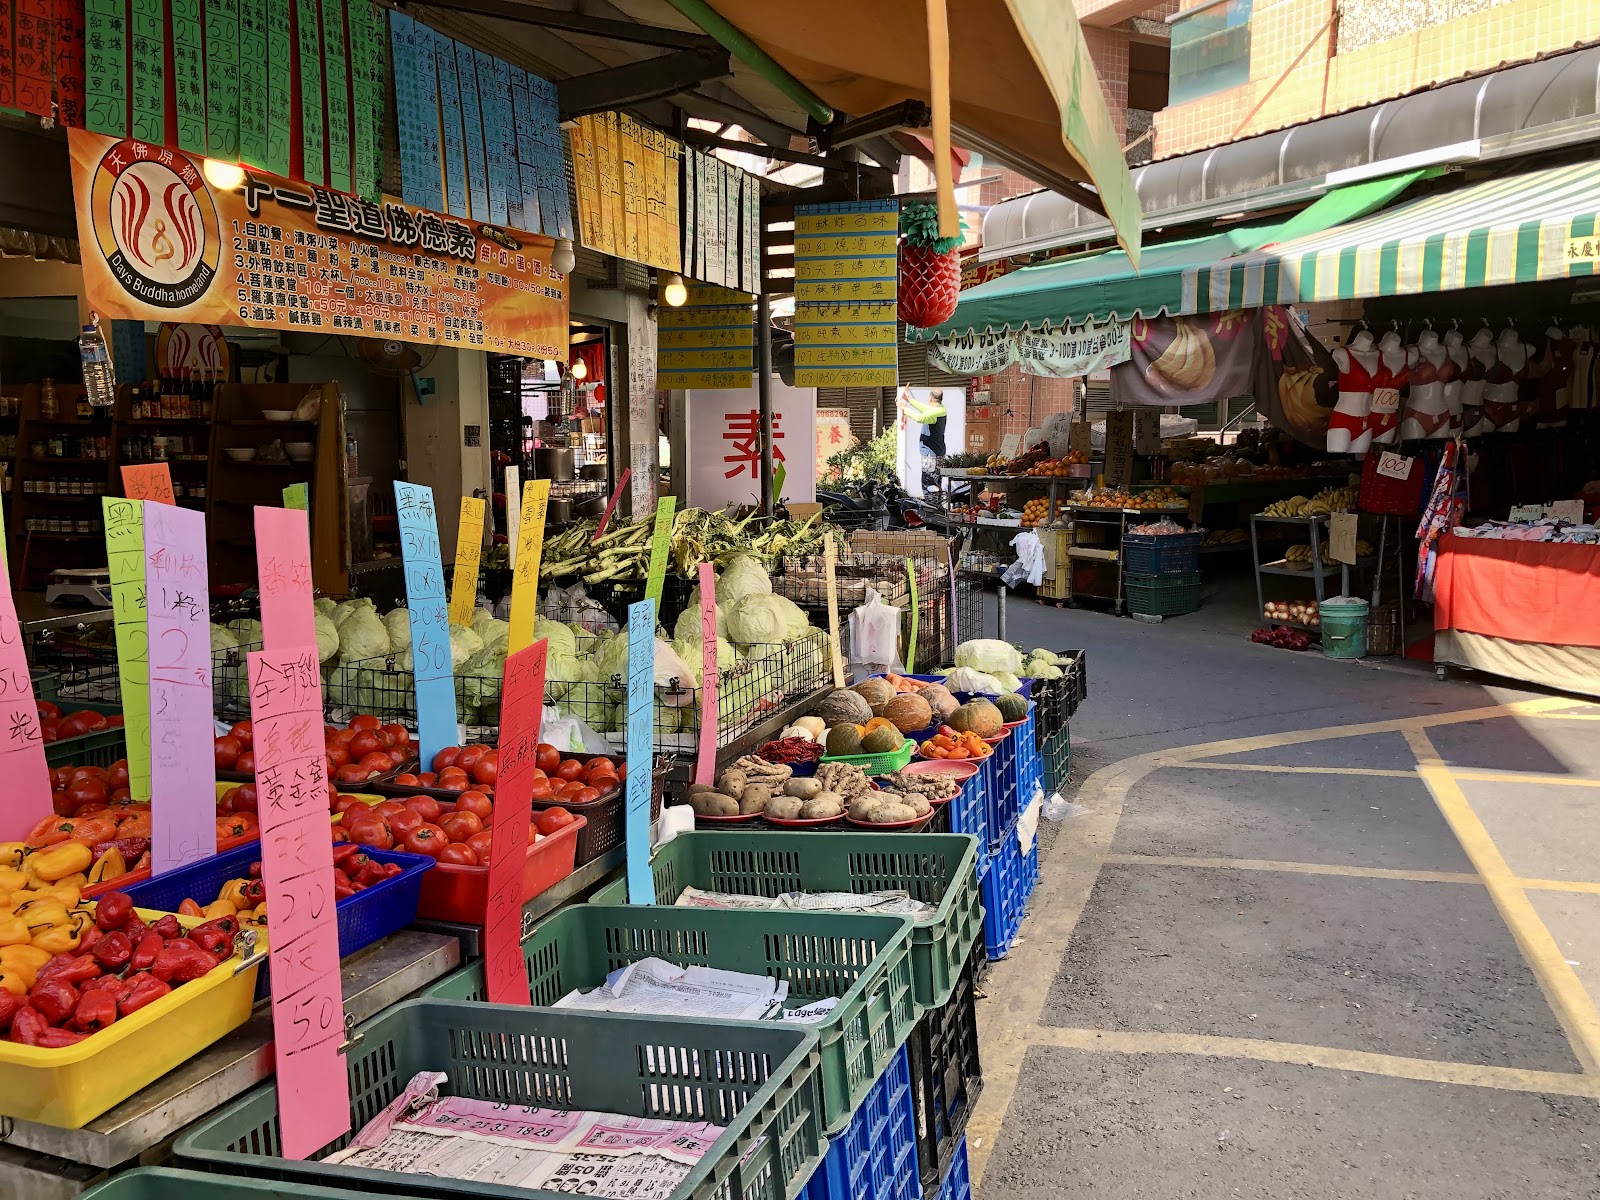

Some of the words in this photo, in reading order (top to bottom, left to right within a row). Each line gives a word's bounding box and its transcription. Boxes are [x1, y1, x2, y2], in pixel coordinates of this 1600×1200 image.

[209, 123, 236, 155] 50
[110, 253, 133, 285] Days
[132, 279, 176, 303] Buddha
[174, 265, 211, 303] homeland
[1376, 388, 1397, 406] 100
[723, 409, 786, 479] 素
[106, 502, 144, 539] 黑
[417, 631, 446, 673] 50
[293, 996, 334, 1042] 50
